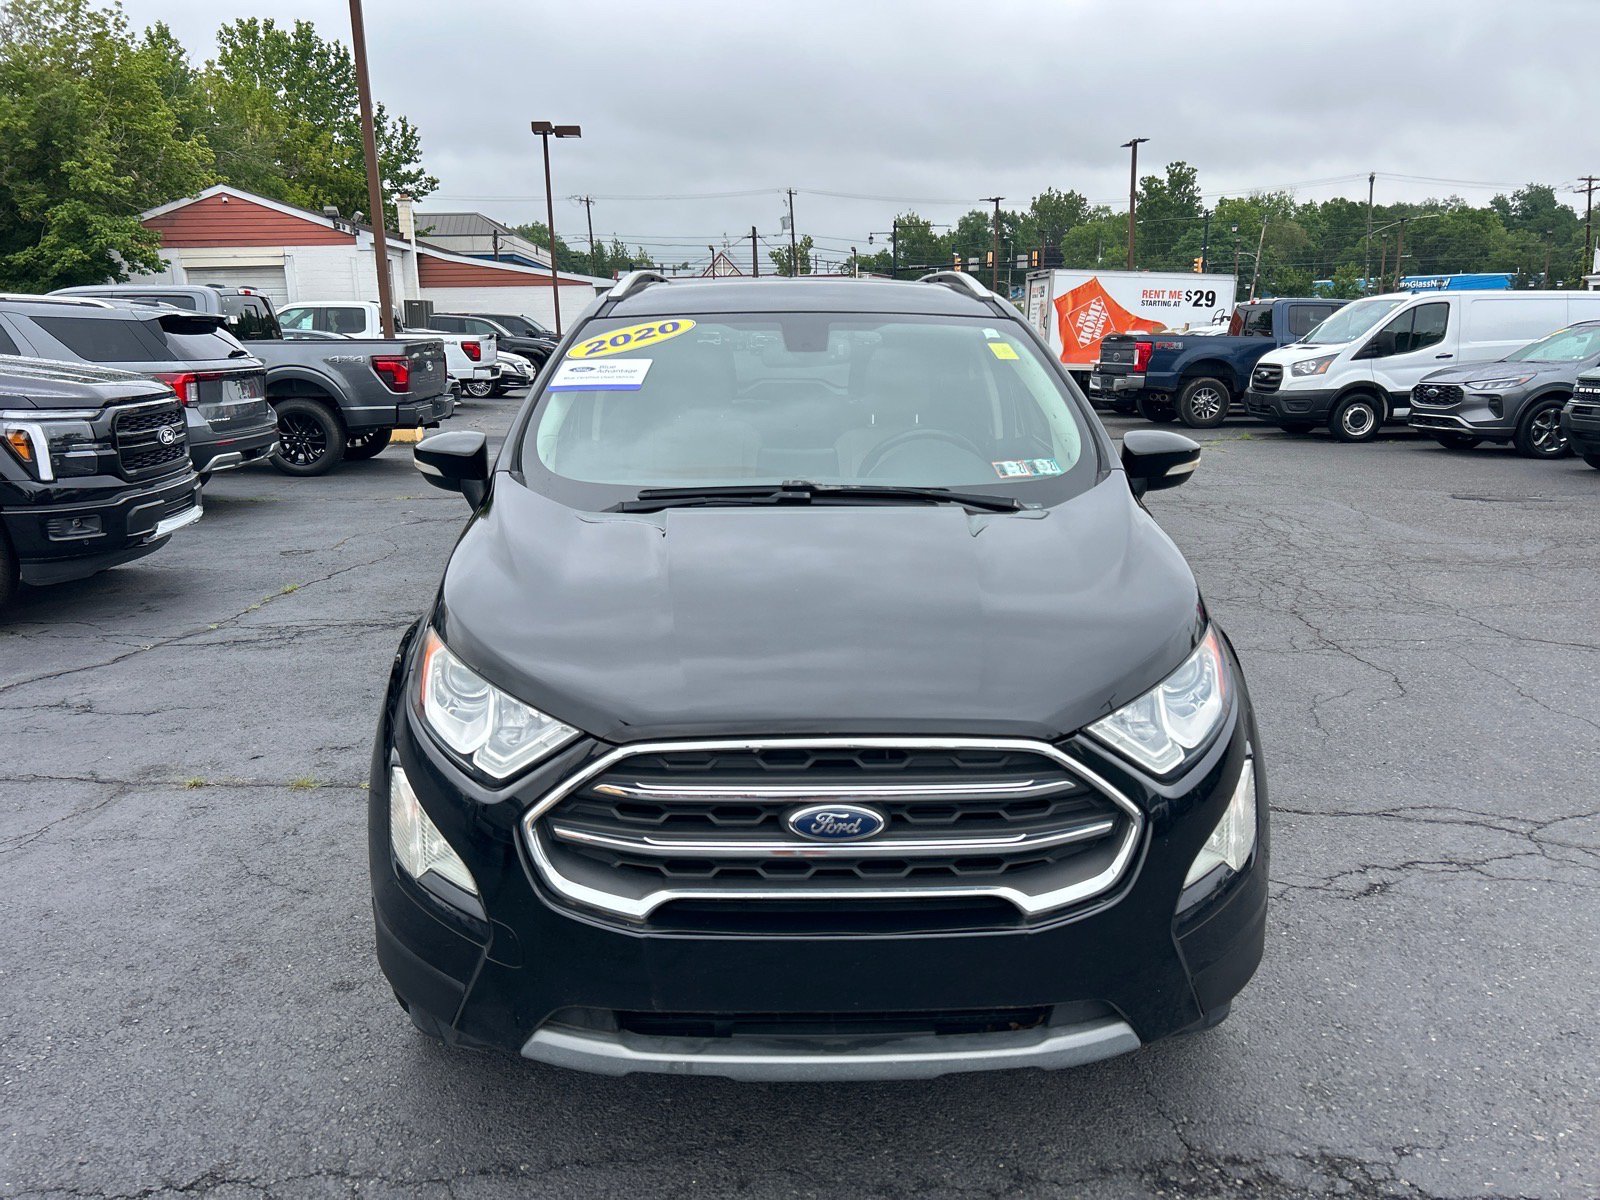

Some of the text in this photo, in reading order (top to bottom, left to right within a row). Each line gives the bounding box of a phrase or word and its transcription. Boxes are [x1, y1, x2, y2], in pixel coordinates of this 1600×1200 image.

[1141, 299, 1171, 307] STARTING
[1142, 289, 1216, 308] RENT ME $29
[1075, 310, 1088, 328] THE
[1079, 299, 1104, 344] HOME
[1093, 310, 1108, 339] DEPOT
[584, 321, 680, 356] 2020
[810, 812, 862, 834] Ford
